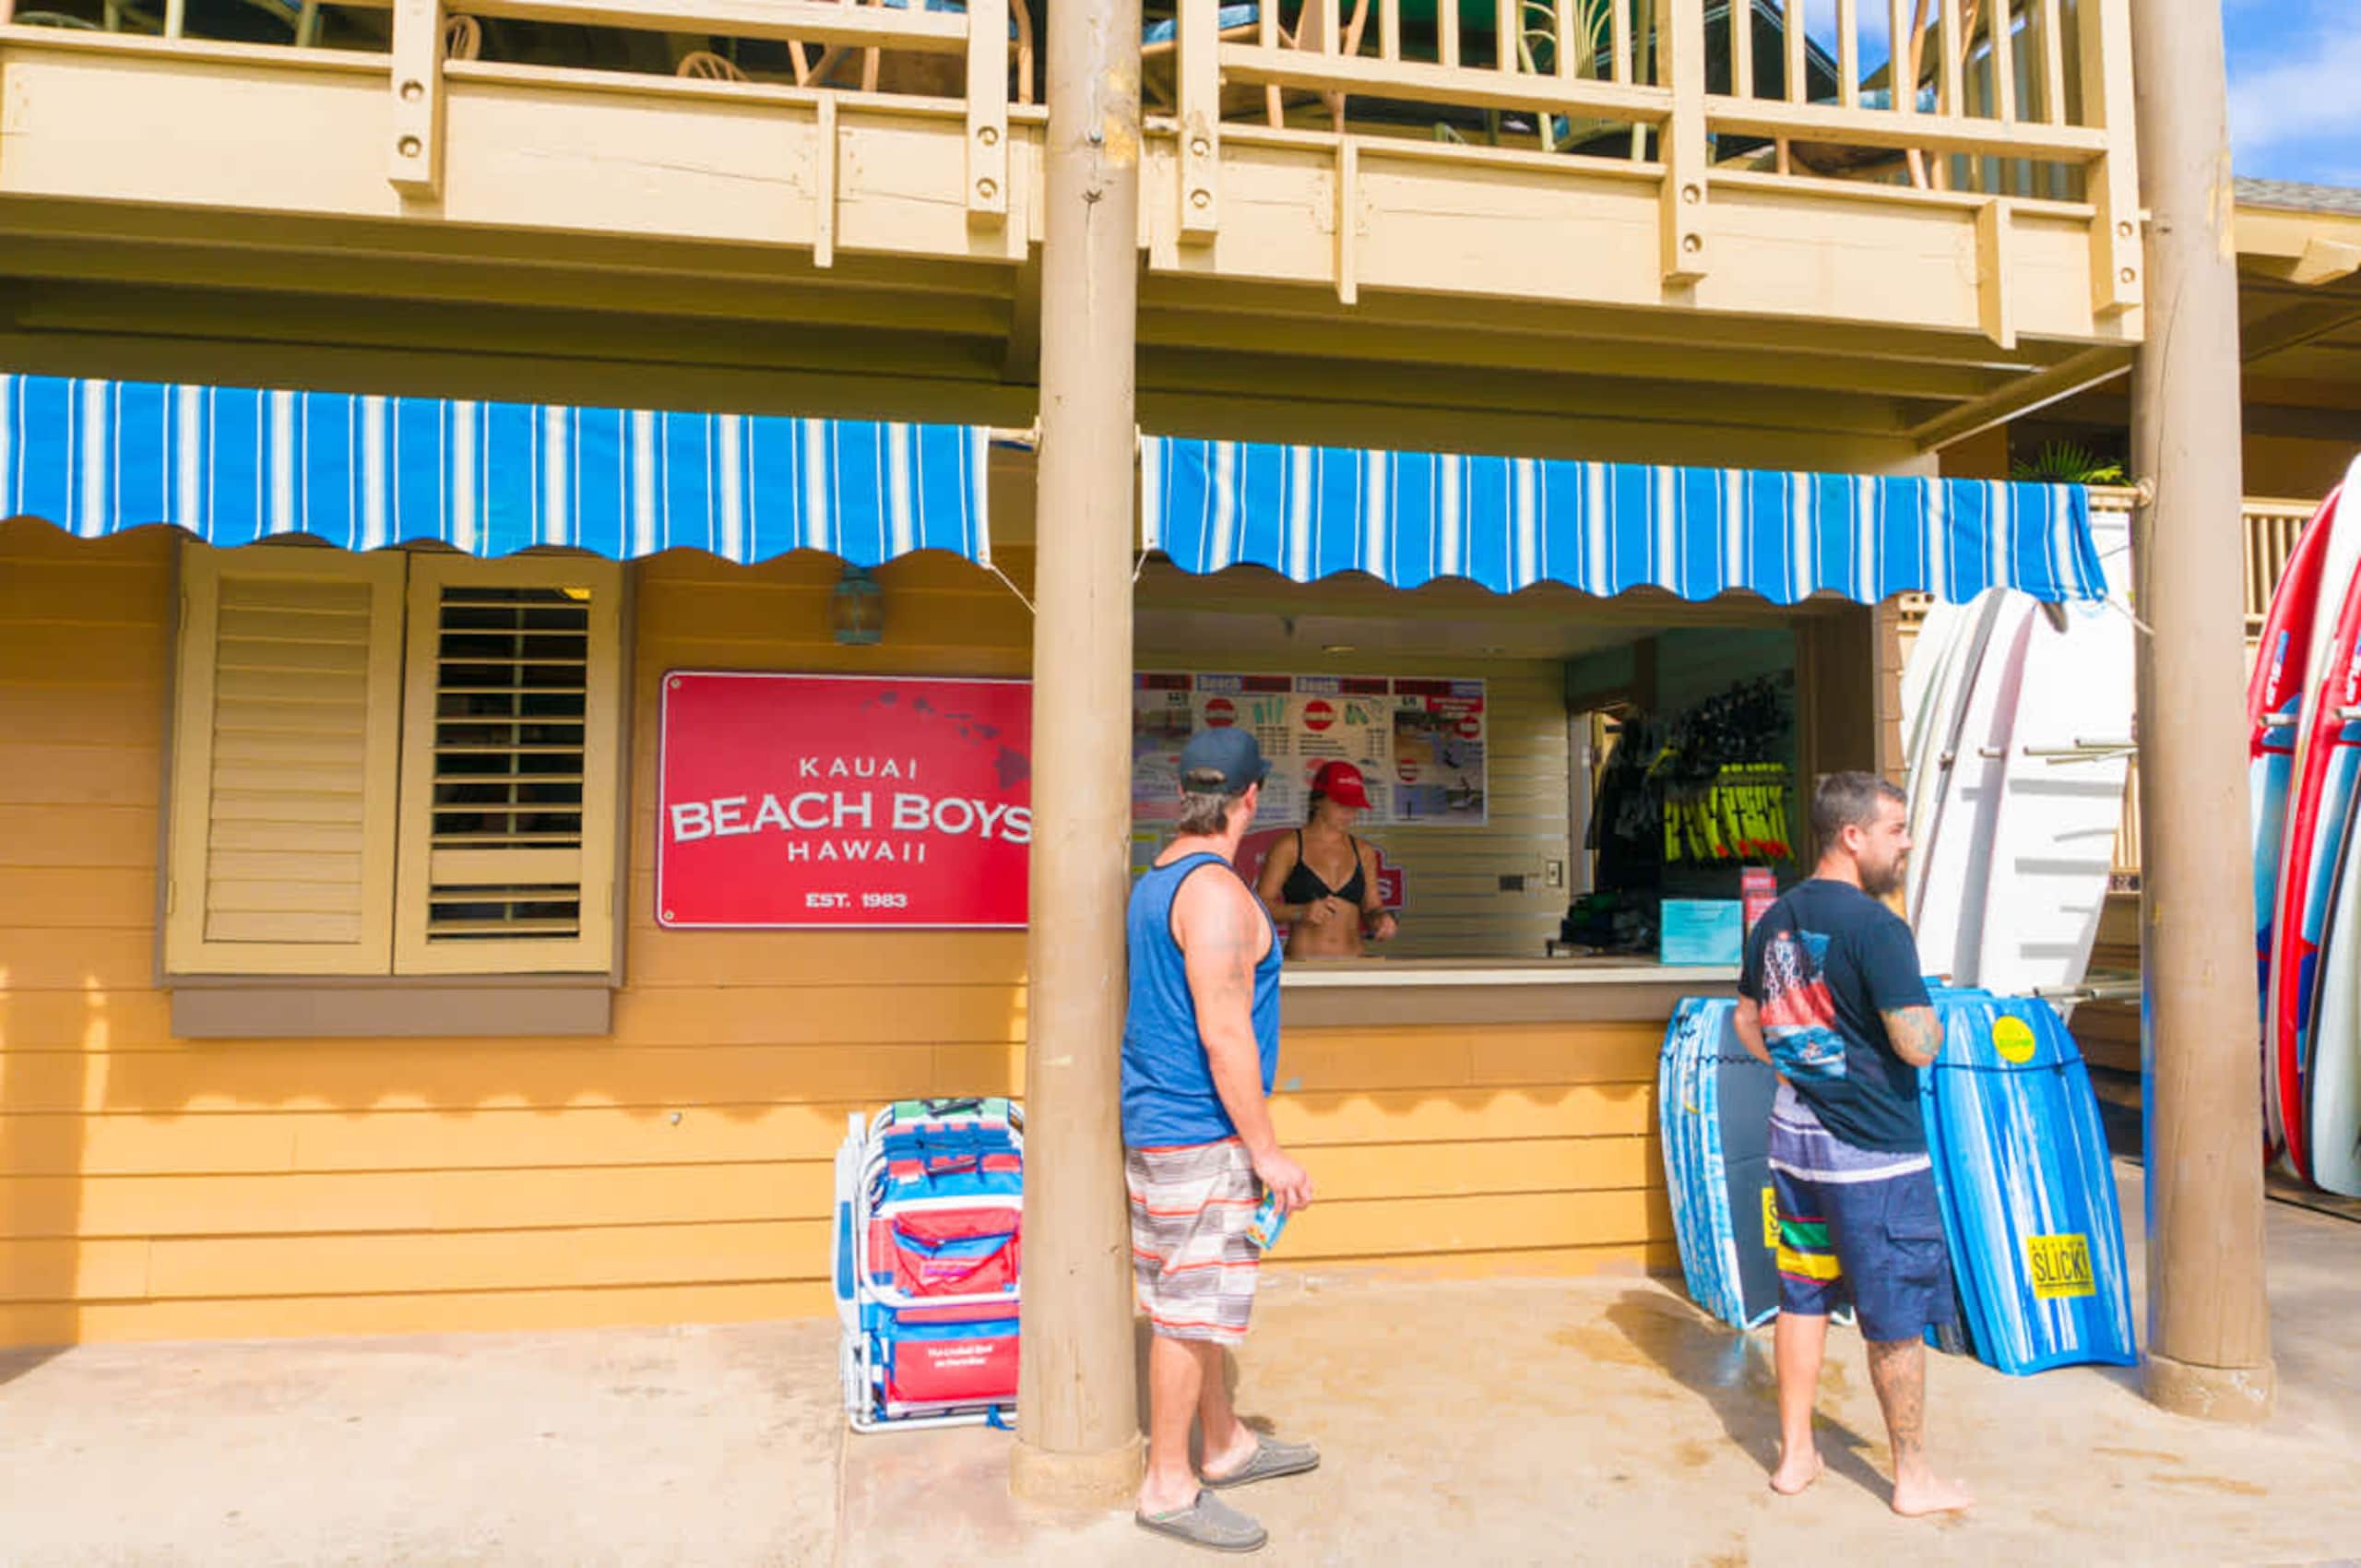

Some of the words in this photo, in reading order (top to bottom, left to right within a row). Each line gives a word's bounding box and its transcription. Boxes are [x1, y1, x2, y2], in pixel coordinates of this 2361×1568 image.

[799, 757, 918, 778] KAUAI
[670, 791, 872, 843] BEACH
[892, 792, 1033, 844] BOYS
[788, 841, 926, 863] HAWAII
[805, 893, 851, 909] EST.
[861, 893, 908, 909] 1983
